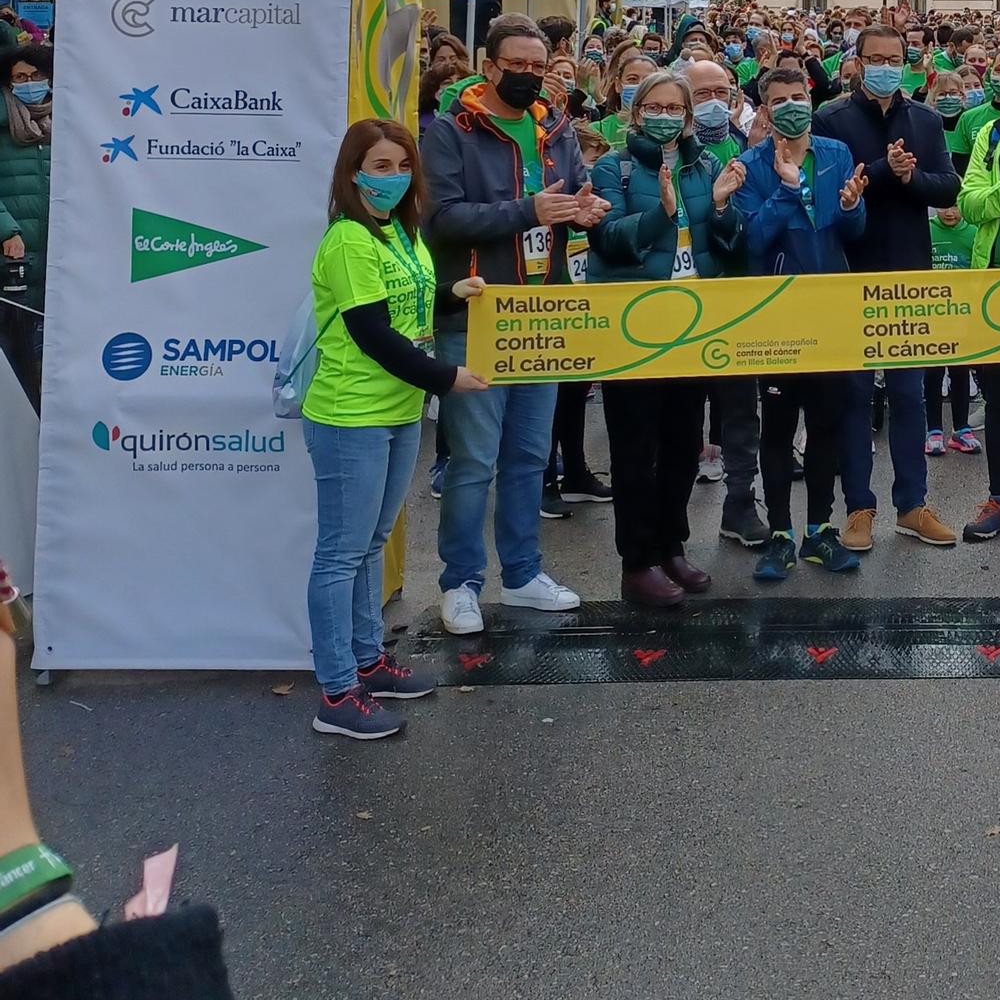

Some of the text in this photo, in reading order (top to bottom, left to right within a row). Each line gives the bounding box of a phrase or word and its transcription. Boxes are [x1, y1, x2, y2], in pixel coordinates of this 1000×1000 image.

[170, 2, 301, 29] marcapital
[170, 88, 282, 111] CaixaBank
[147, 140, 225, 156] Fundació
[863, 284, 952, 301] Mallorca
[496, 297, 590, 313] Mallorca
[863, 299, 971, 318] en marcha
[496, 312, 610, 332] en marcha
[863, 320, 930, 337] contra
[162, 338, 281, 362] SAMPOL
[495, 335, 565, 351] contra
[863, 339, 959, 358] el cáncer
[736, 349, 762, 357] contra
[160, 364, 223, 376] ENERGÍA
[494, 353, 595, 372] el cáncer
[121, 430, 284, 458] quirónsalud
[133, 462, 280, 473] La salud persona a persona
